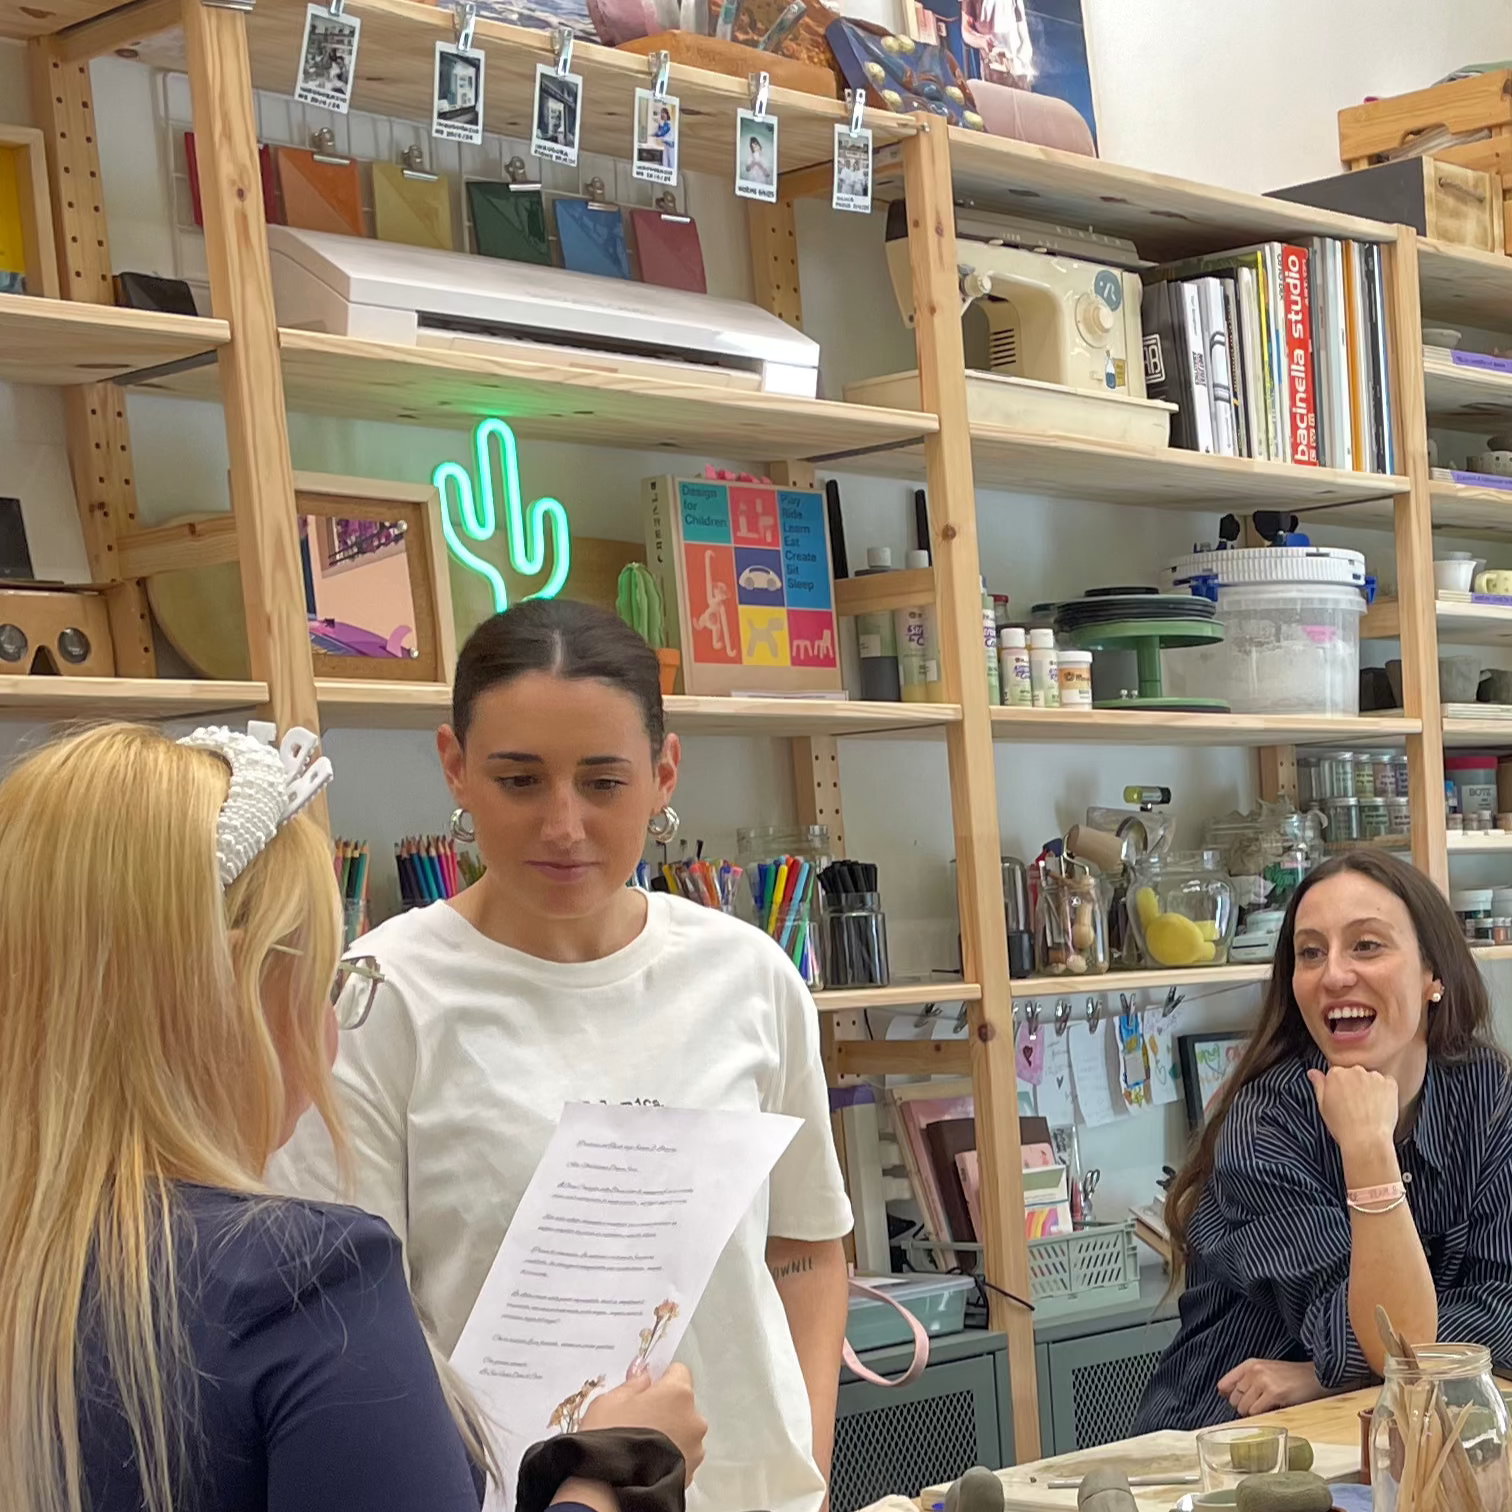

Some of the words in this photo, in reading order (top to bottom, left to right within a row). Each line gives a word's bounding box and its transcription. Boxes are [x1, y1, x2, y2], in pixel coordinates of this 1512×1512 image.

[1285, 254, 1304, 339] studio
[1290, 348, 1309, 461] bacinella
[682, 484, 718, 500] Design
[683, 499, 698, 511] for
[781, 494, 801, 507] Play
[782, 508, 803, 519] Ride
[685, 513, 728, 528] Children
[783, 522, 811, 534] Learn
[784, 536, 800, 547] Eat
[785, 550, 817, 562] Create
[786, 563, 799, 575] Sit
[787, 577, 815, 592] Sleep
